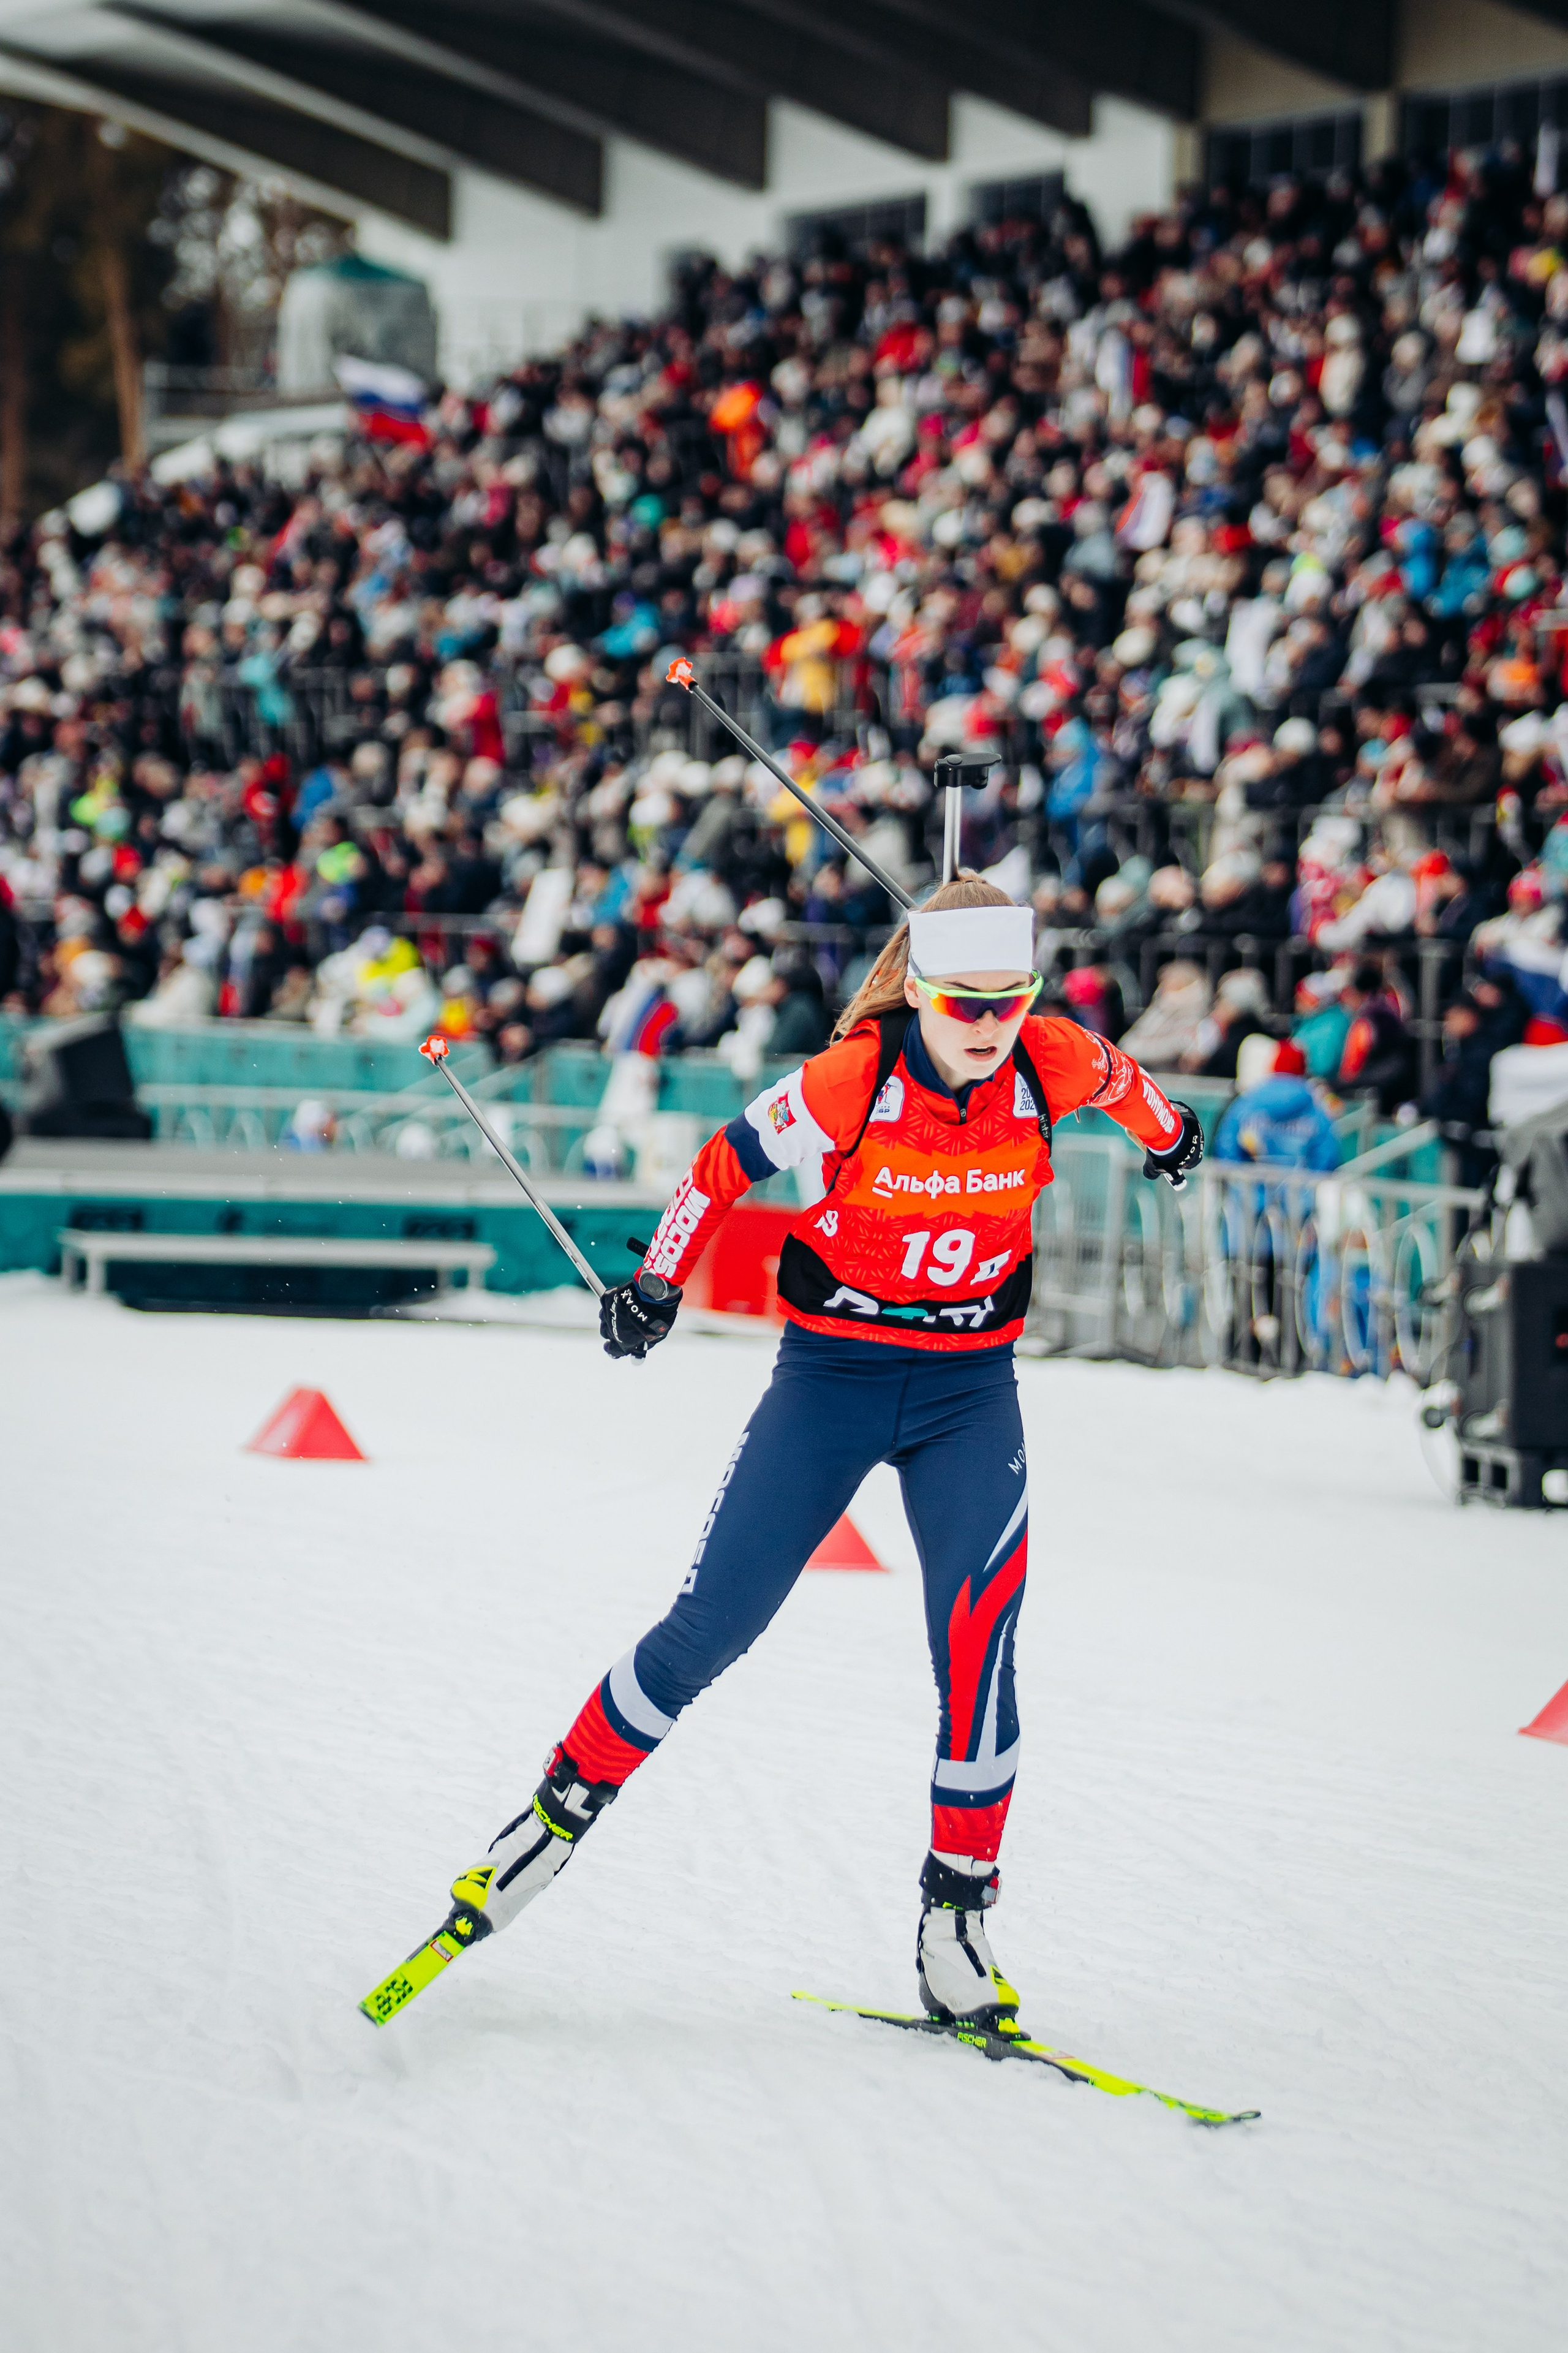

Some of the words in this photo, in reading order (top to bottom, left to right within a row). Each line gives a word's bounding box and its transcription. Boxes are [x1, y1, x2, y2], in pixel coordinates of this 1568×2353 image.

[1020, 1099, 1035, 1111] 202
[872, 1166, 960, 1199] Альфа
[966, 1168, 1025, 1193] Банк
[652, 1185, 711, 1279] МОСОБ
[901, 1228, 976, 1286] 19
[620, 1290, 648, 1322] MOAX
[957, 2032, 987, 2048] FISCHER
